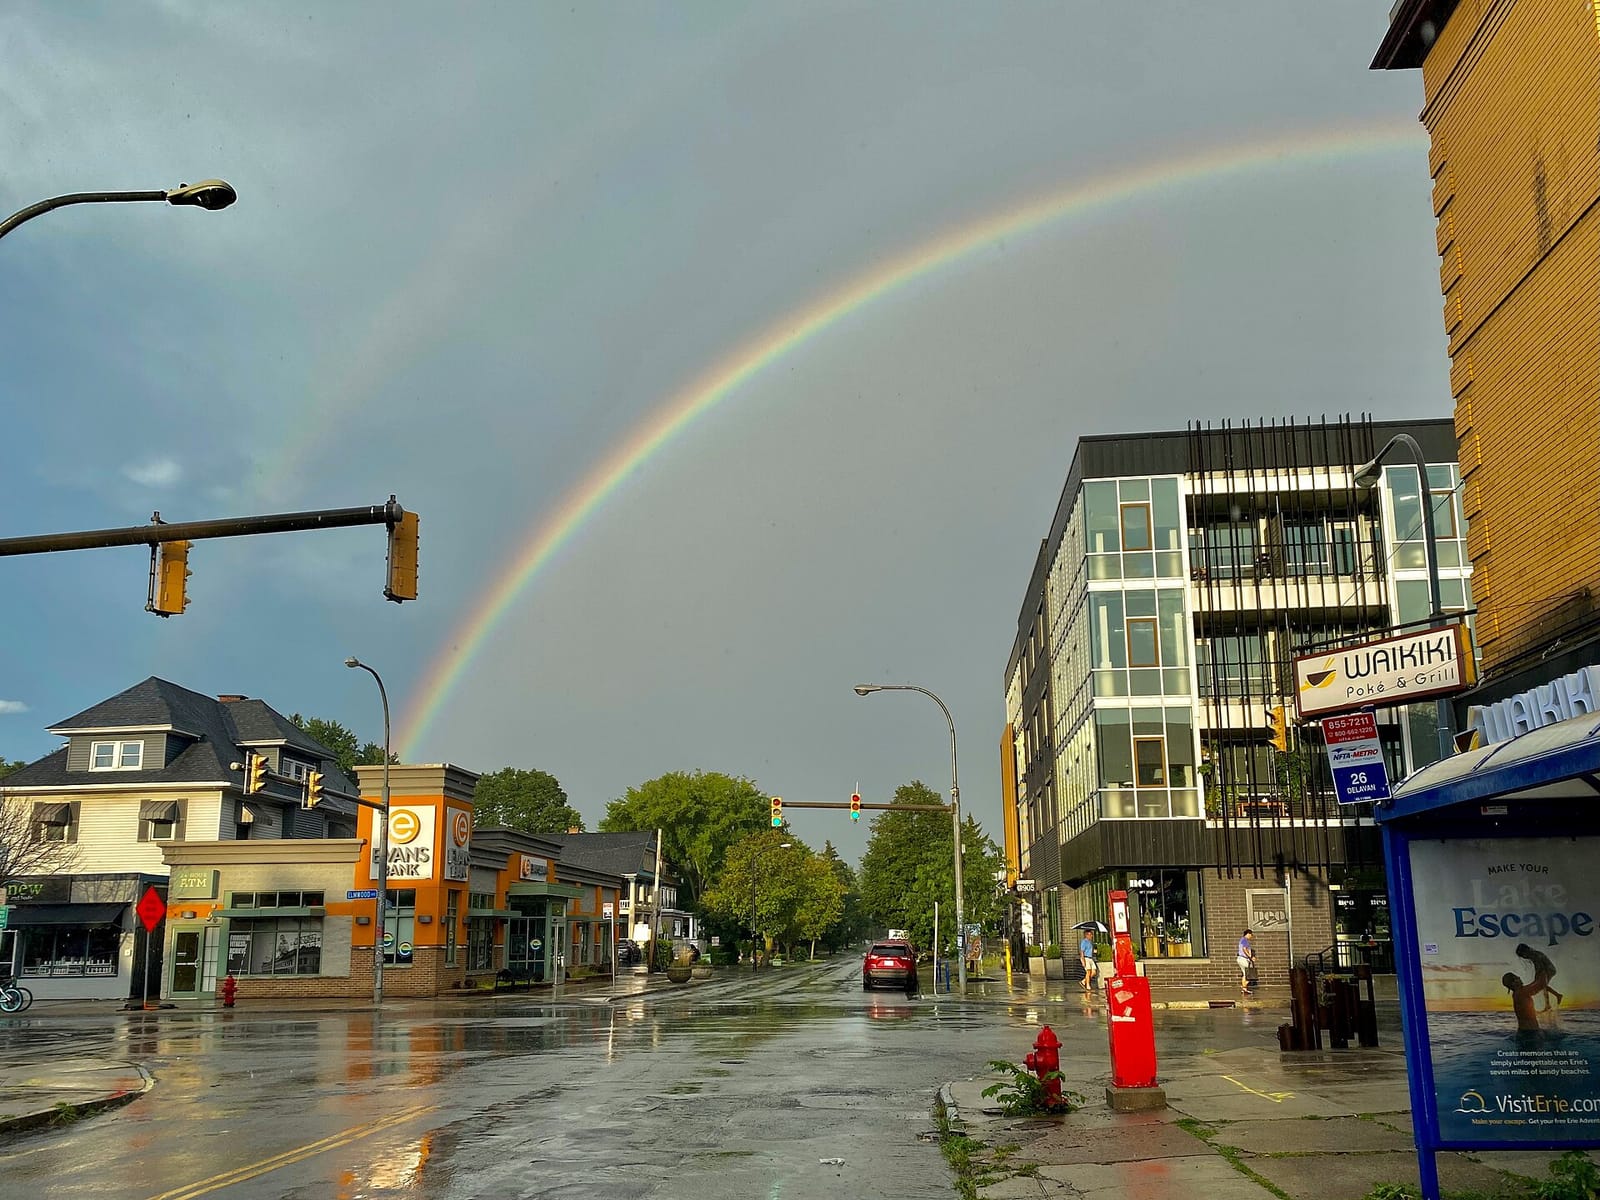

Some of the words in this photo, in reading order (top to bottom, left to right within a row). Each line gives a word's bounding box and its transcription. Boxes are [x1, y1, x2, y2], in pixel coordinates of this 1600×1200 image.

[1344, 635, 1452, 679] WAIKIKI
[1346, 681, 1385, 698] Poké
[1396, 677, 1407, 688] &
[1414, 667, 1454, 684] Grill
[1328, 717, 1369, 730] 855-7211
[1350, 772, 1368, 785] 26
[1346, 784, 1376, 795] DELAVAN
[373, 847, 430, 864] EVANS
[1487, 864, 1516, 876] MAKE
[1519, 863, 1549, 875] YOUR
[180, 879, 207, 888] ATM
[347, 891, 370, 899] ELMWOOD
[1471, 876, 1568, 909] Lake
[1452, 906, 1594, 947] Escape
[1513, 1059, 1559, 1067] unforgettable
[1539, 1068, 1560, 1076] sandy
